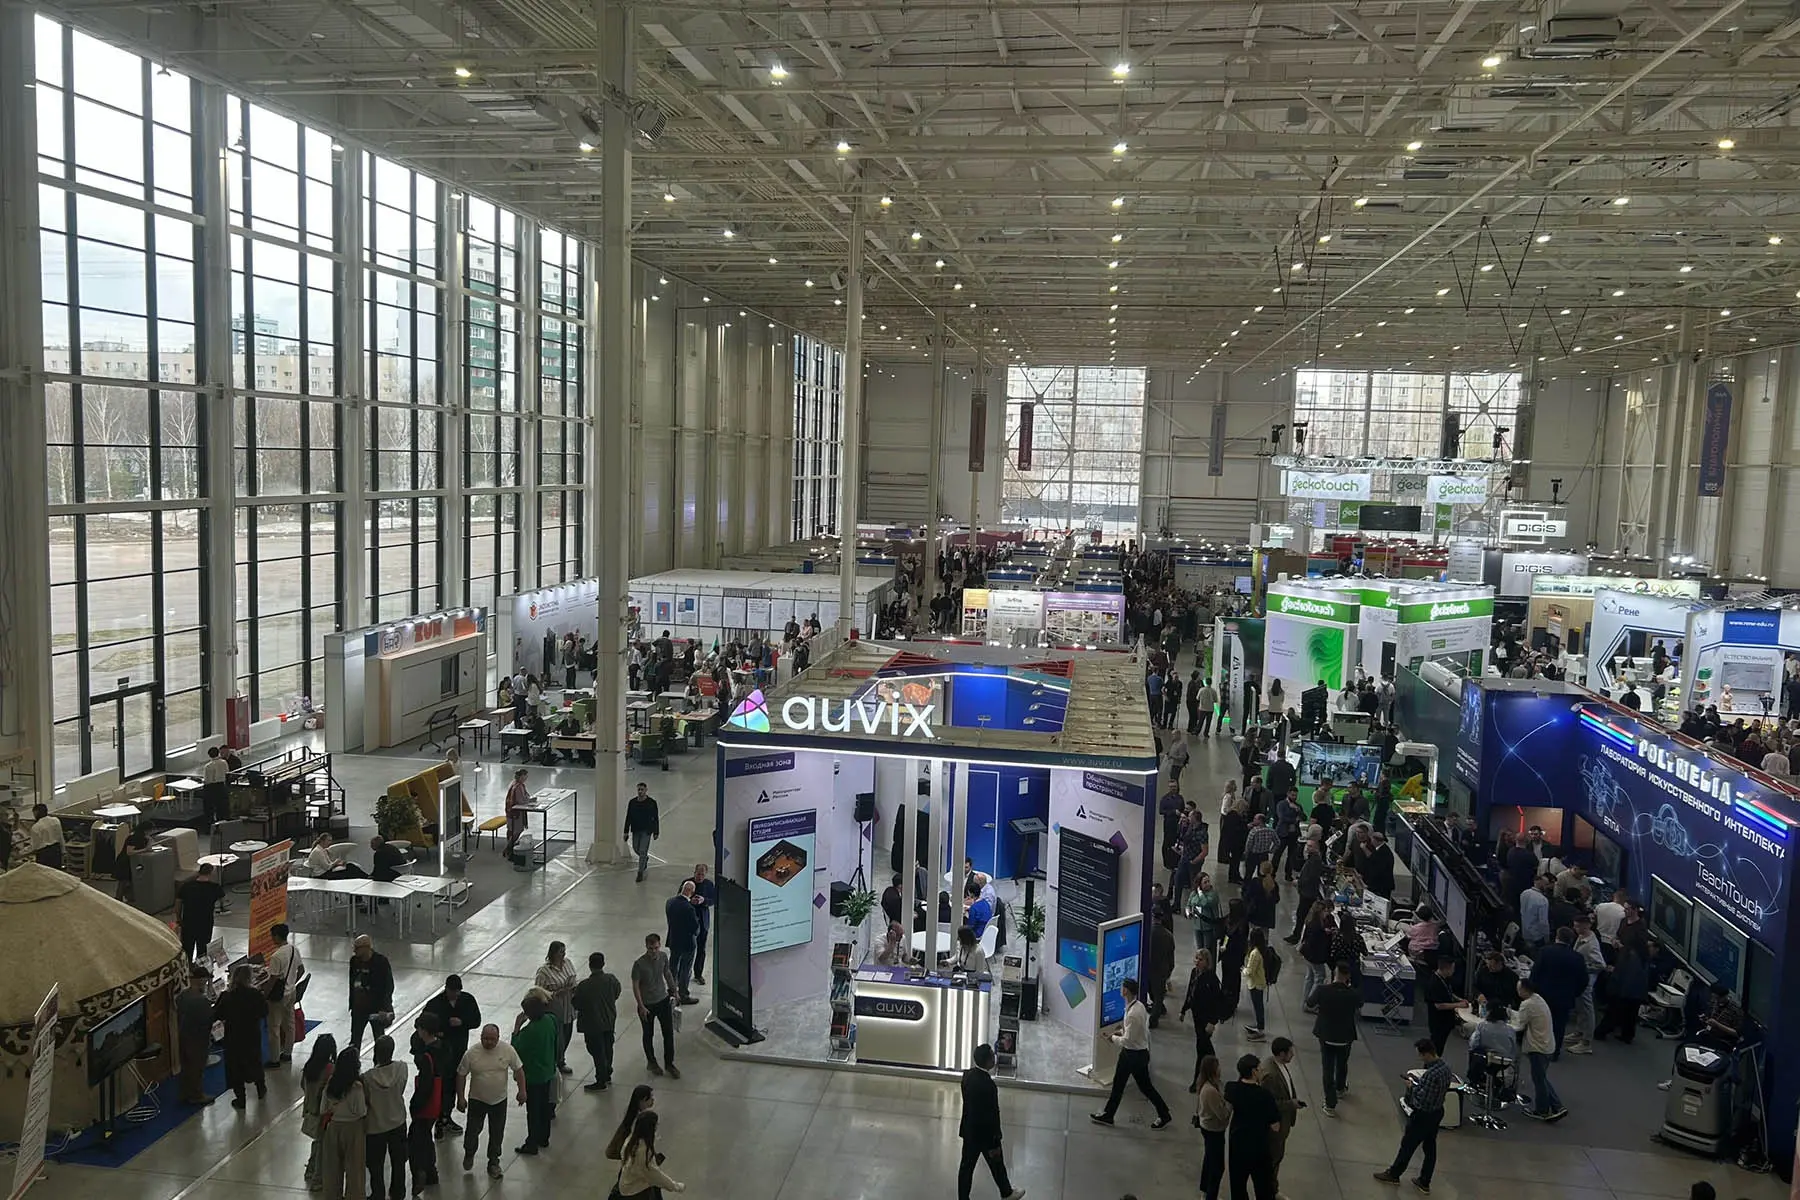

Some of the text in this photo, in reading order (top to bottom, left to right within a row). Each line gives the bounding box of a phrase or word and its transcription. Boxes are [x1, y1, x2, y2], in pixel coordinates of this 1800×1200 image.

[1292, 475, 1359, 494] geckotouch
[1618, 605, 1640, 617] Рене
[782, 691, 935, 738] auvix
[745, 759, 792, 770] Входная зона
[1638, 738, 1731, 805] POLYMEDIA
[1600, 744, 1647, 778] ЛАБОРАТОРИЯ
[1648, 772, 1721, 821] ИСКУССТВЕННОГО
[1696, 860, 1763, 920] TeachTouch
[1696, 881, 1736, 914] ИНТЕРАКТИВНЫЕ
[876, 1002, 916, 1015] auvix
